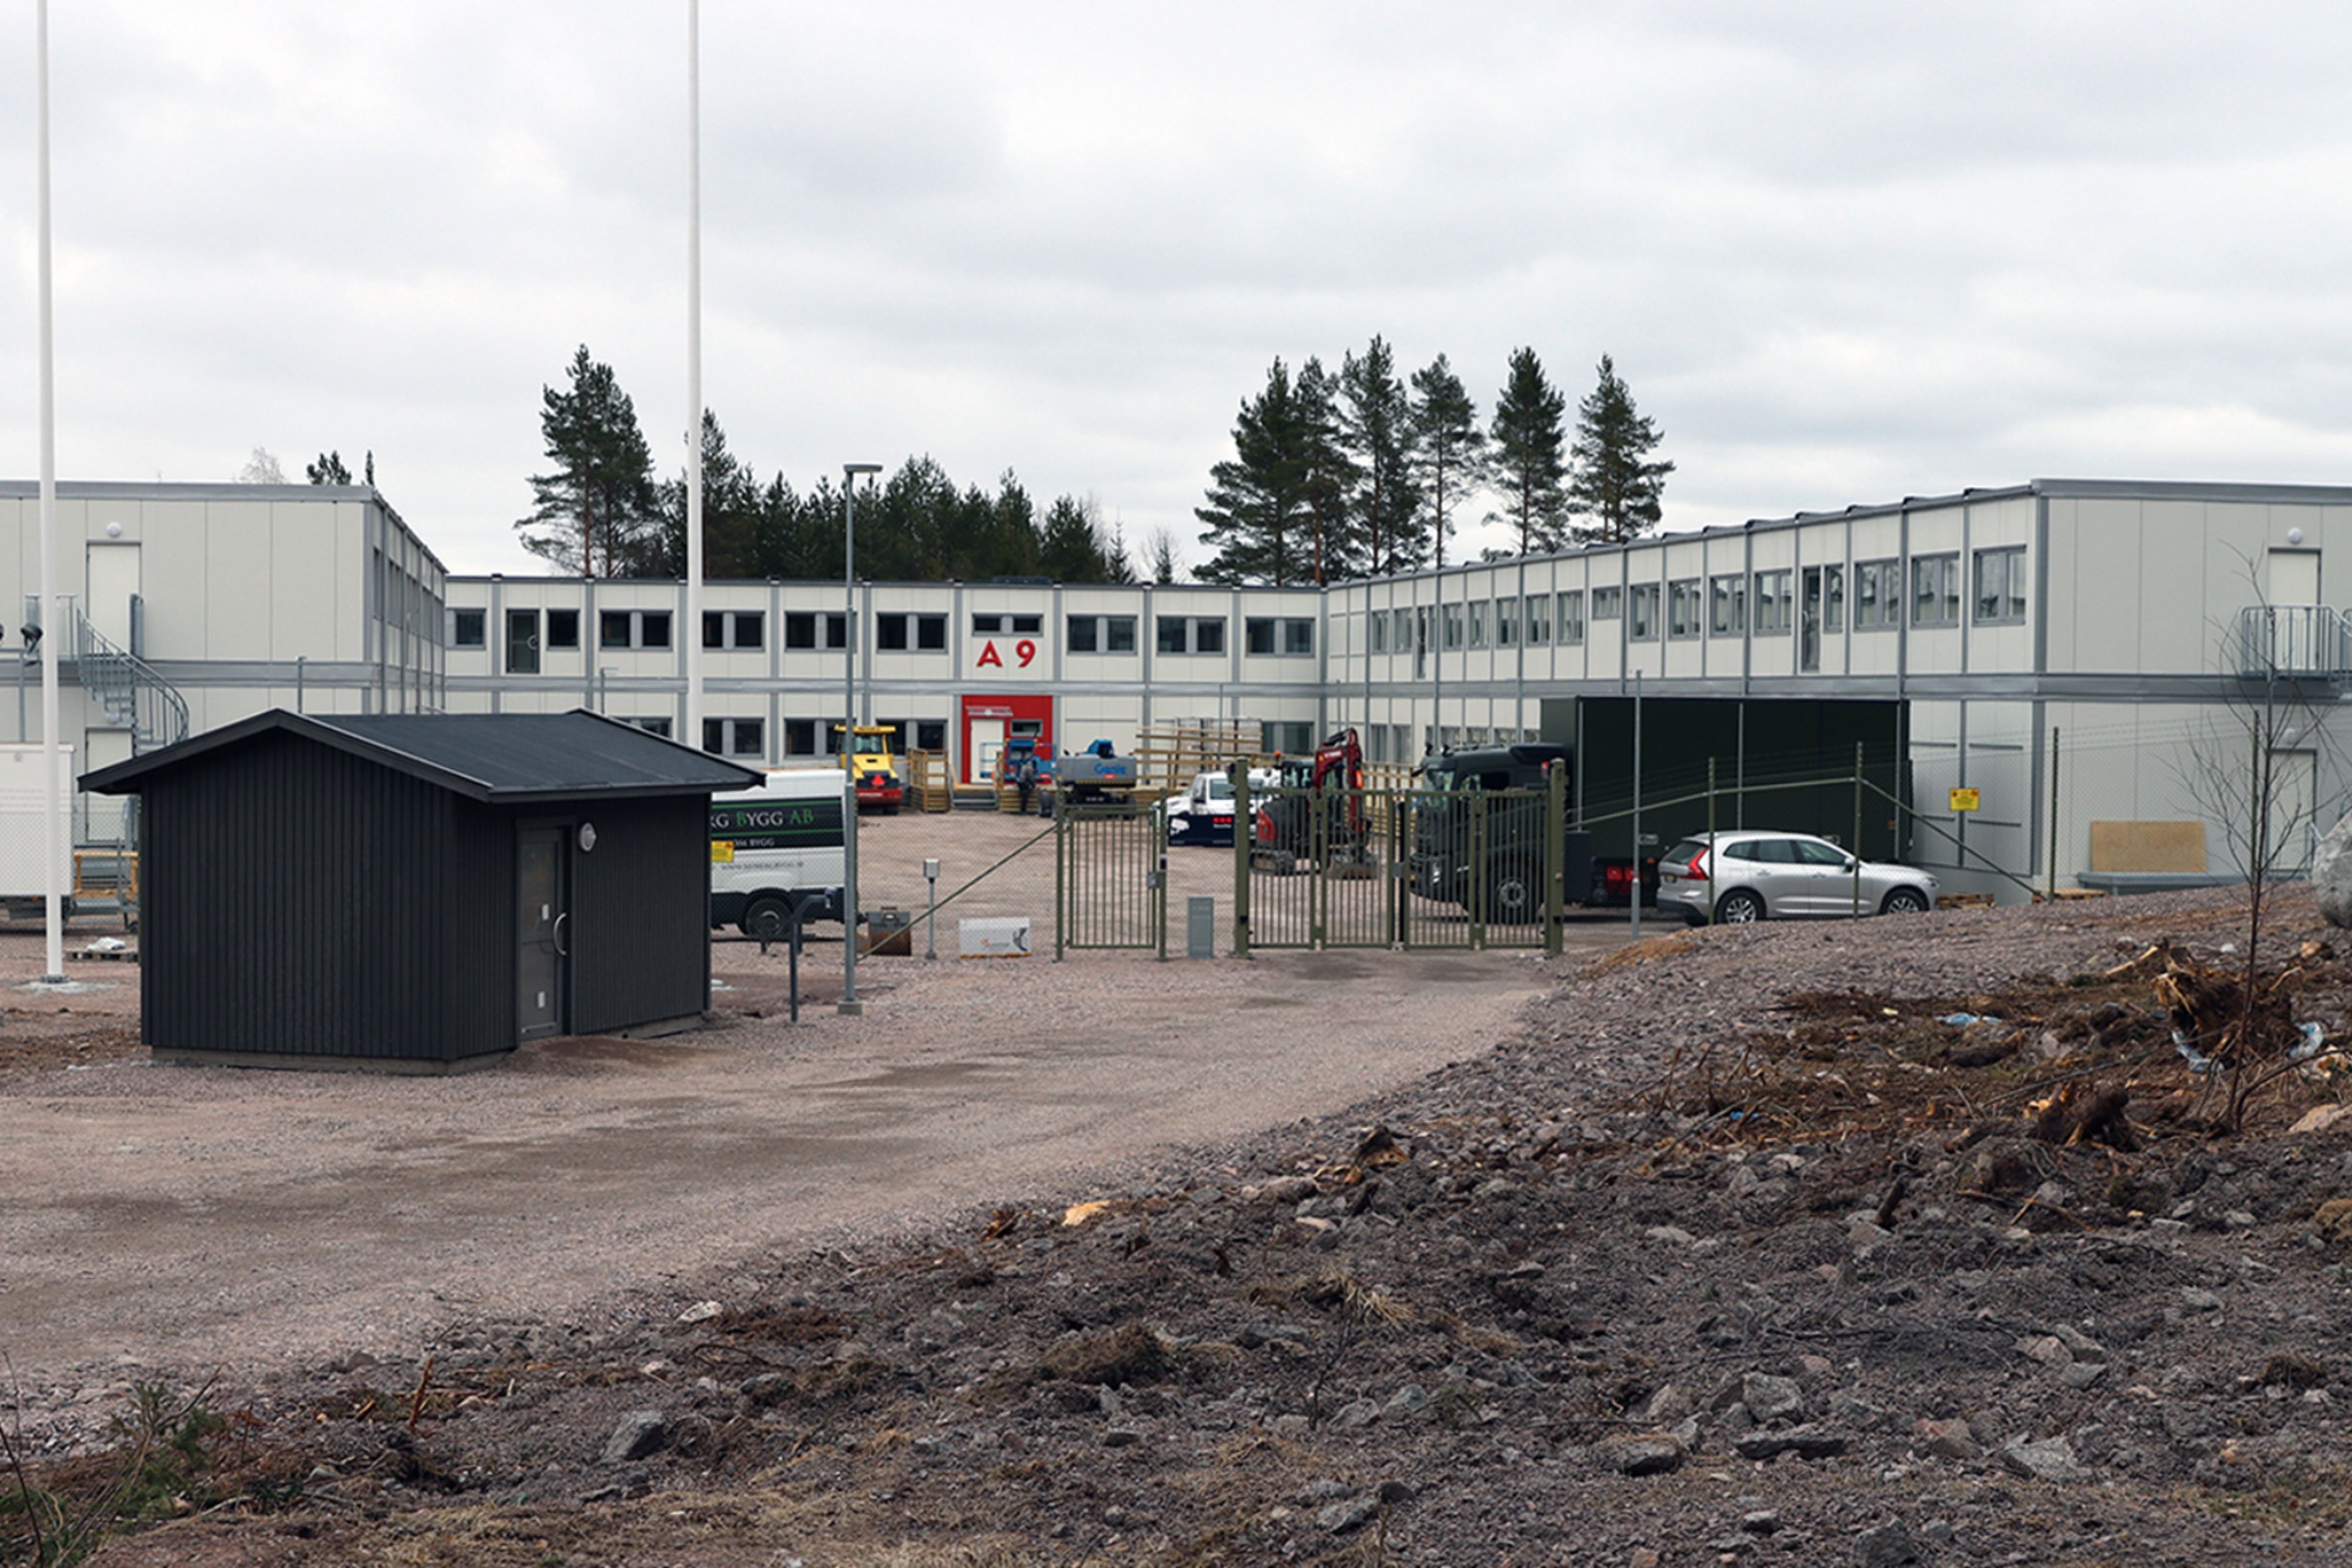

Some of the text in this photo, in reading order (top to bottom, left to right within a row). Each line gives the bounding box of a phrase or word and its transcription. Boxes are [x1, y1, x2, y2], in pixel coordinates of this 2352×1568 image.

[976, 638, 1037, 668] A 9
[736, 810, 784, 827] BYGG
[790, 809, 814, 824] AB
